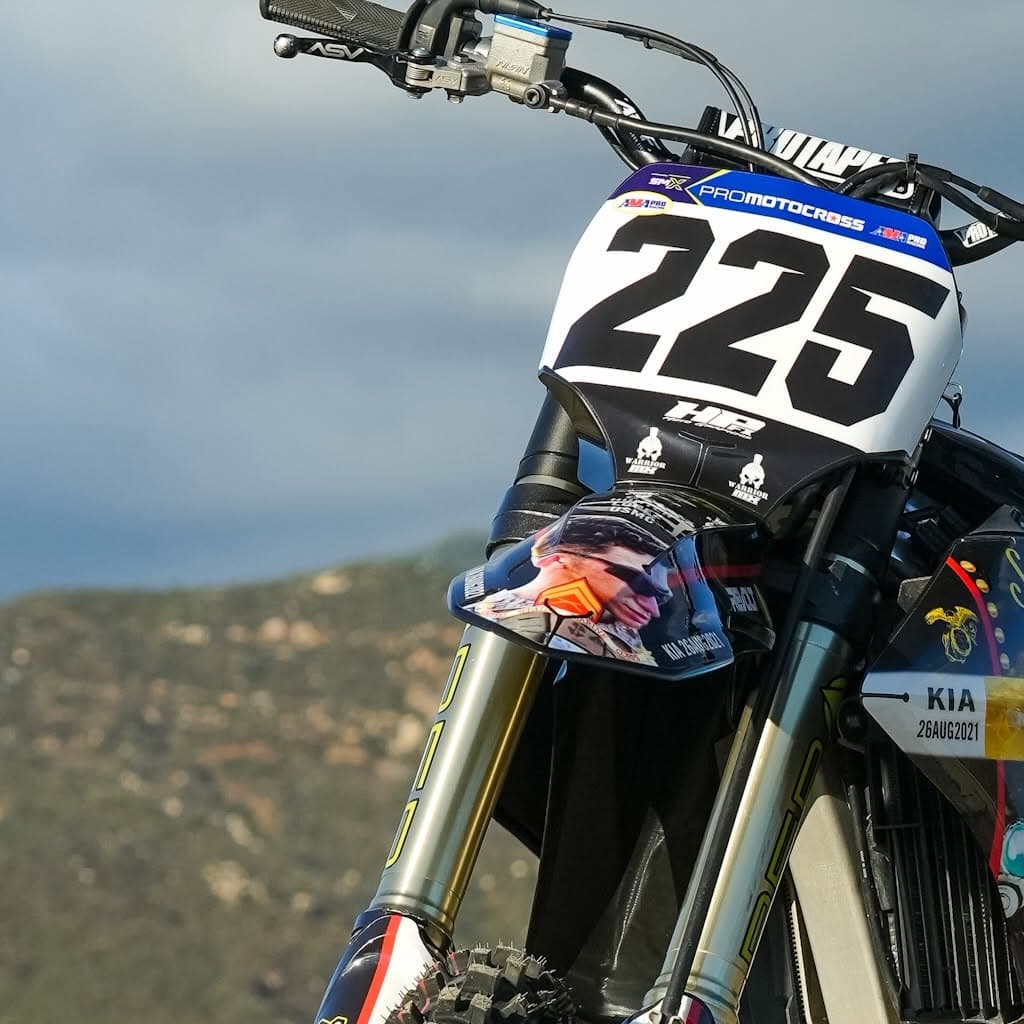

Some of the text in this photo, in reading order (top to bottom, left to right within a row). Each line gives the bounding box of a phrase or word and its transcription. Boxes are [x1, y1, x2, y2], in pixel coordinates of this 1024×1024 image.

[309, 42, 365, 60] ASV
[553, 214, 951, 427] 225
[625, 457, 667, 469] WARRIOR
[728, 480, 769, 500] WARRIOR
[927, 686, 977, 713] KIA
[916, 719, 979, 742] 26AUG2021
